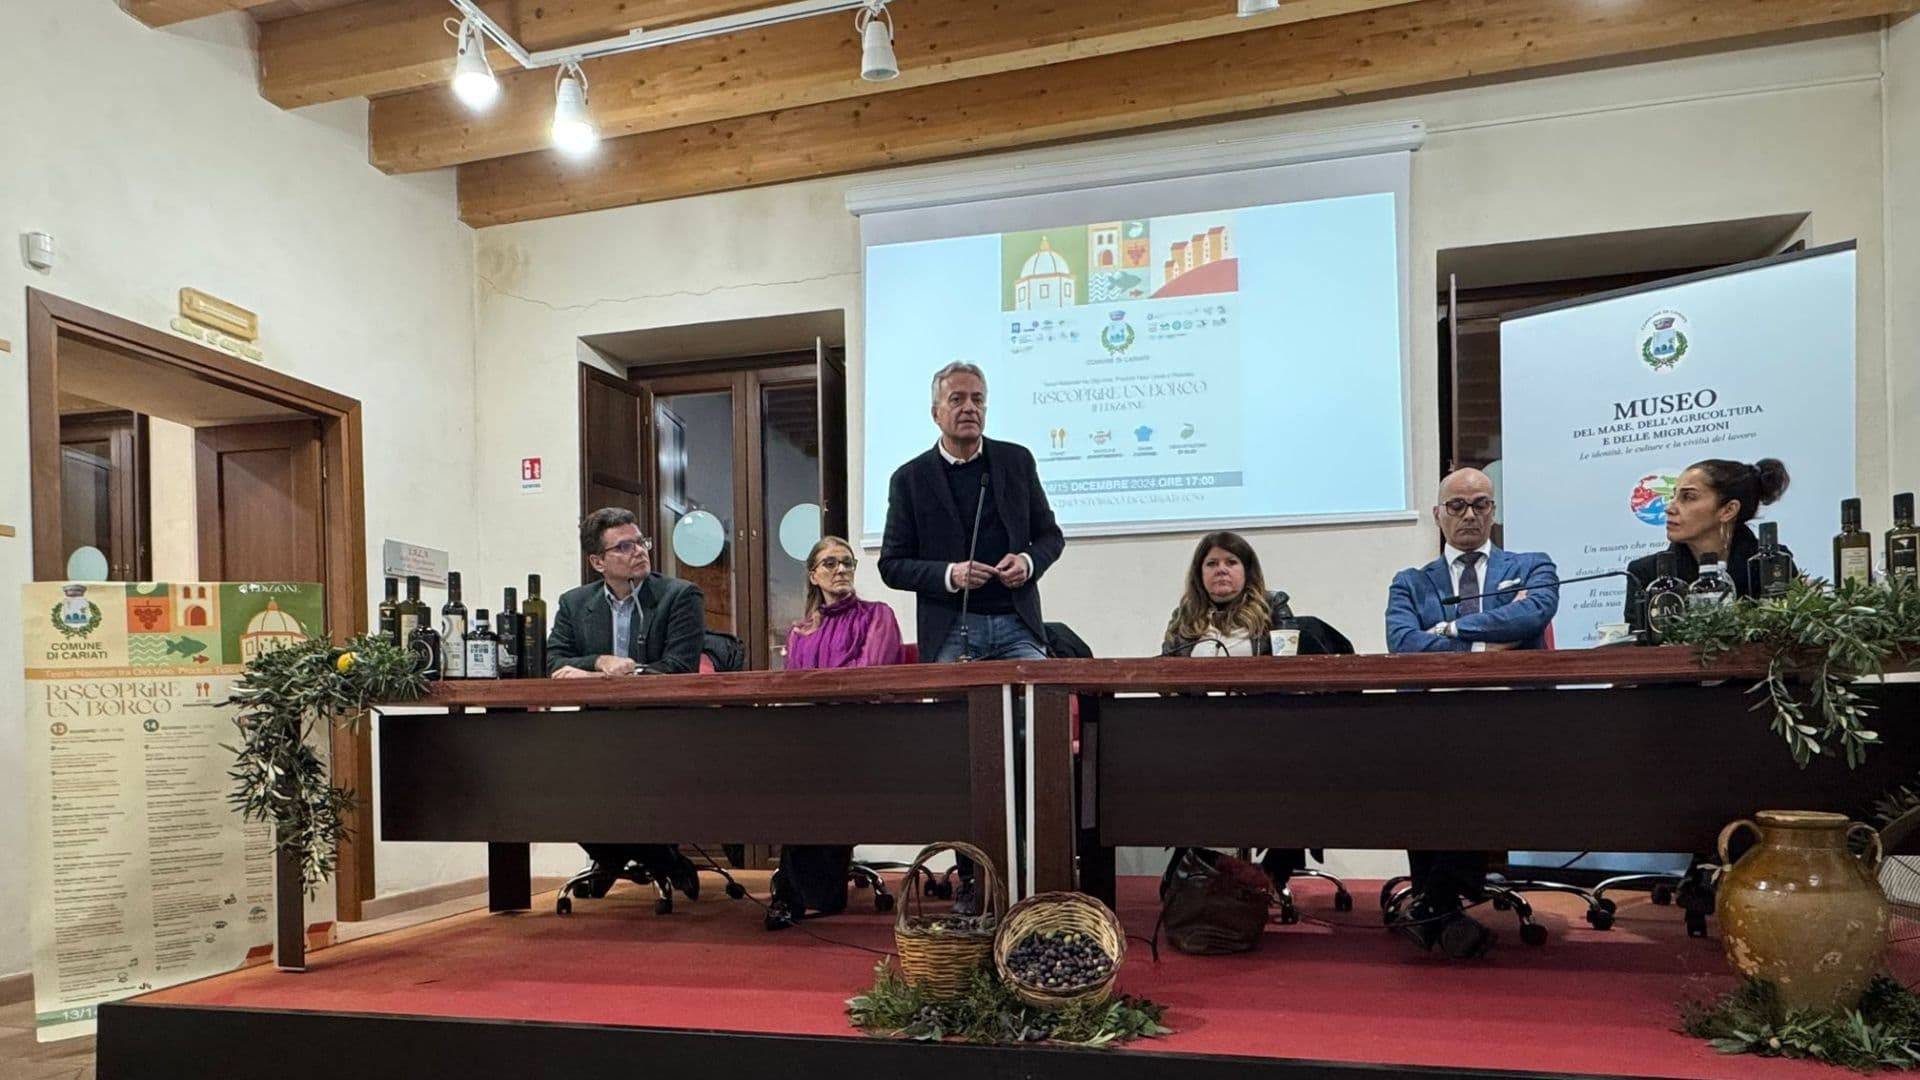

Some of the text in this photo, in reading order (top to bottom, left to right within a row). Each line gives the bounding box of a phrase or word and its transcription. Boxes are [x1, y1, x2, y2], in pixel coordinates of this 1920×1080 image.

[1613, 388, 1718, 421] MUSEO
[1573, 427, 1596, 439] DEL
[1637, 404, 1764, 430] DELL'AGRICOLTURA
[1603, 421, 1730, 446] E DELLE MIGRAZIONI
[1579, 452, 1590, 461] Le
[1673, 440, 1681, 449] la
[1712, 434, 1726, 444] del
[1727, 432, 1757, 443] lavoro
[1071, 480, 1129, 492] DICEMBRE
[1131, 478, 1156, 490] 2024
[1158, 477, 1183, 488] ORE
[1583, 544, 1596, 554] Un
[1631, 541, 1647, 550] che
[50, 641, 103, 651] COMUNE
[46, 650, 108, 661] DI CARIATI
[46, 701, 81, 718] UN
[63, 1007, 98, 1021] 13/1
